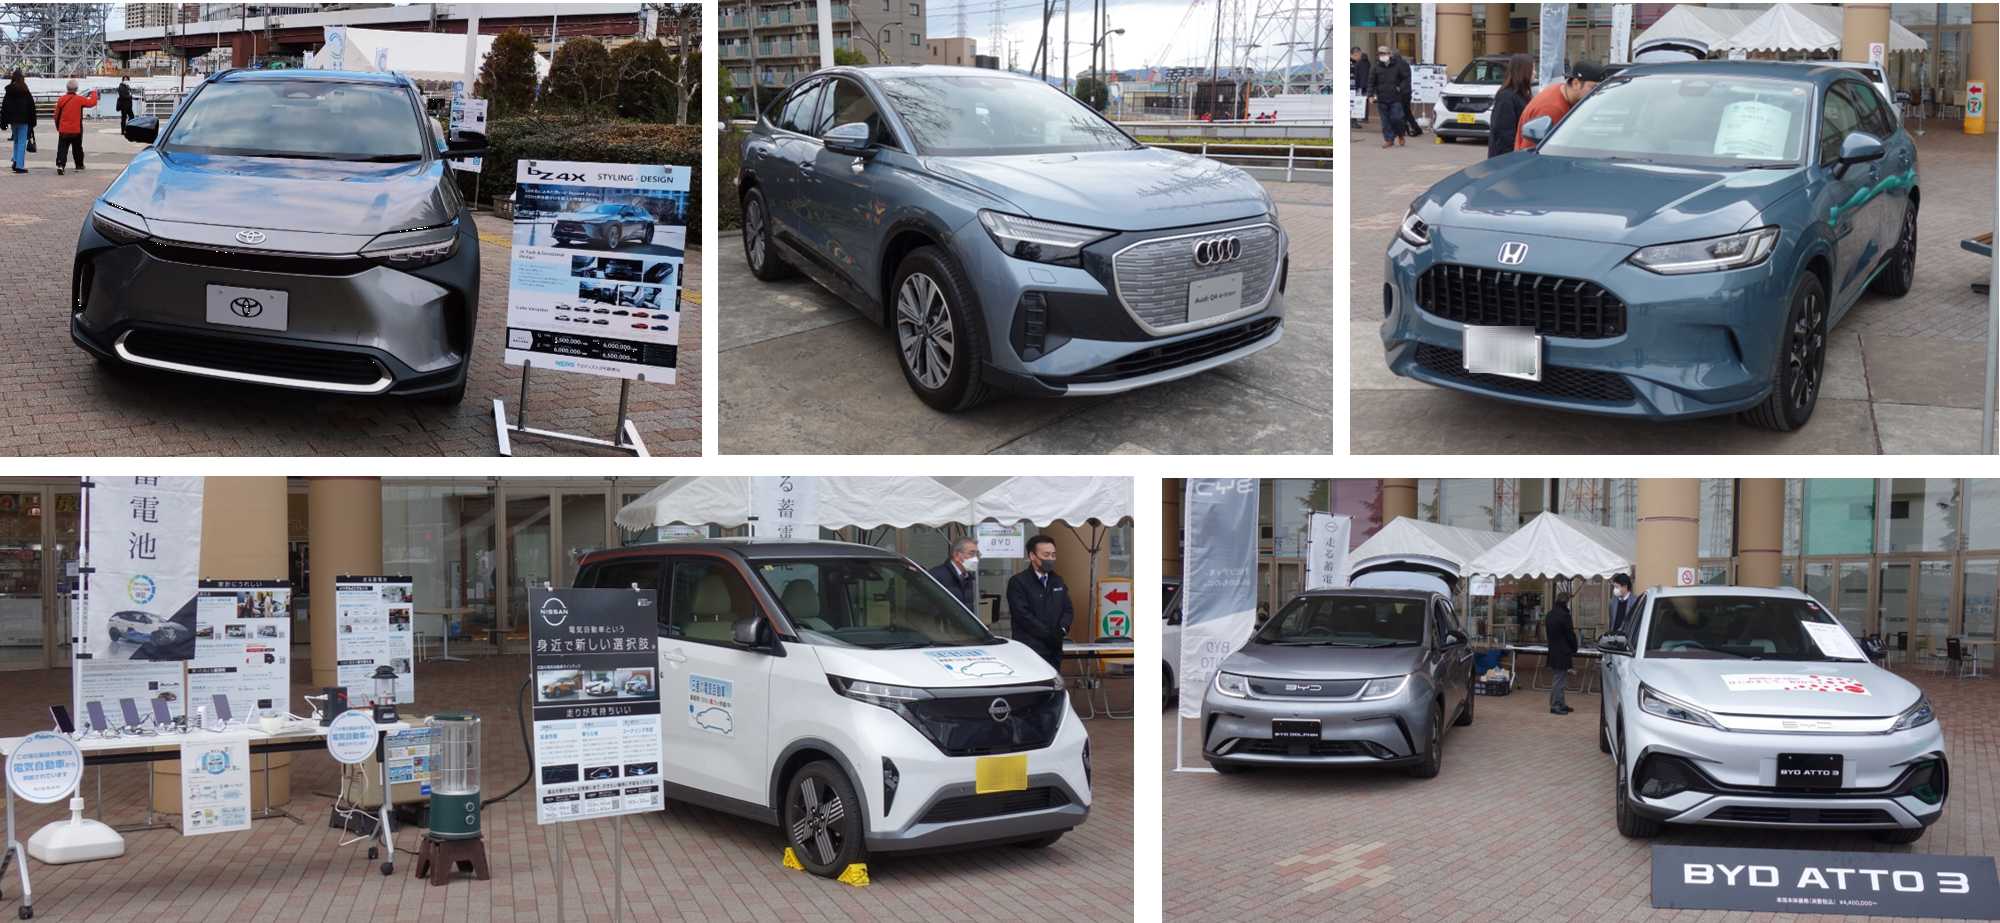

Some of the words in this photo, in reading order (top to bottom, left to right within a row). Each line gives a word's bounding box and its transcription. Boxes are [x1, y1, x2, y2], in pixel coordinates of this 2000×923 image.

[527, 167, 586, 183] bZ4X
[597, 173, 634, 182] STYLING
[641, 175, 674, 184] DESIGN
[1194, 294, 1209, 304] Audi
[1219, 290, 1237, 298] e-tron
[555, 360, 575, 368] WEINS
[990, 538, 1011, 546] BYD
[568, 625, 625, 634] 電気自動車という
[537, 637, 656, 652] 身近で新しい選択肢。
[566, 706, 632, 718] 走りが気持ちいい
[1782, 720, 1832, 729] BYD
[332, 731, 374, 741] 電気自動車から
[16, 750, 72, 760] この電化製品の電力は
[13, 759, 76, 773] 電気自動車から
[23, 771, 67, 781] 供給されています
[1683, 863, 1780, 888] BYD
[1796, 867, 1925, 893] ATTO
[1936, 871, 1970, 894] 3
